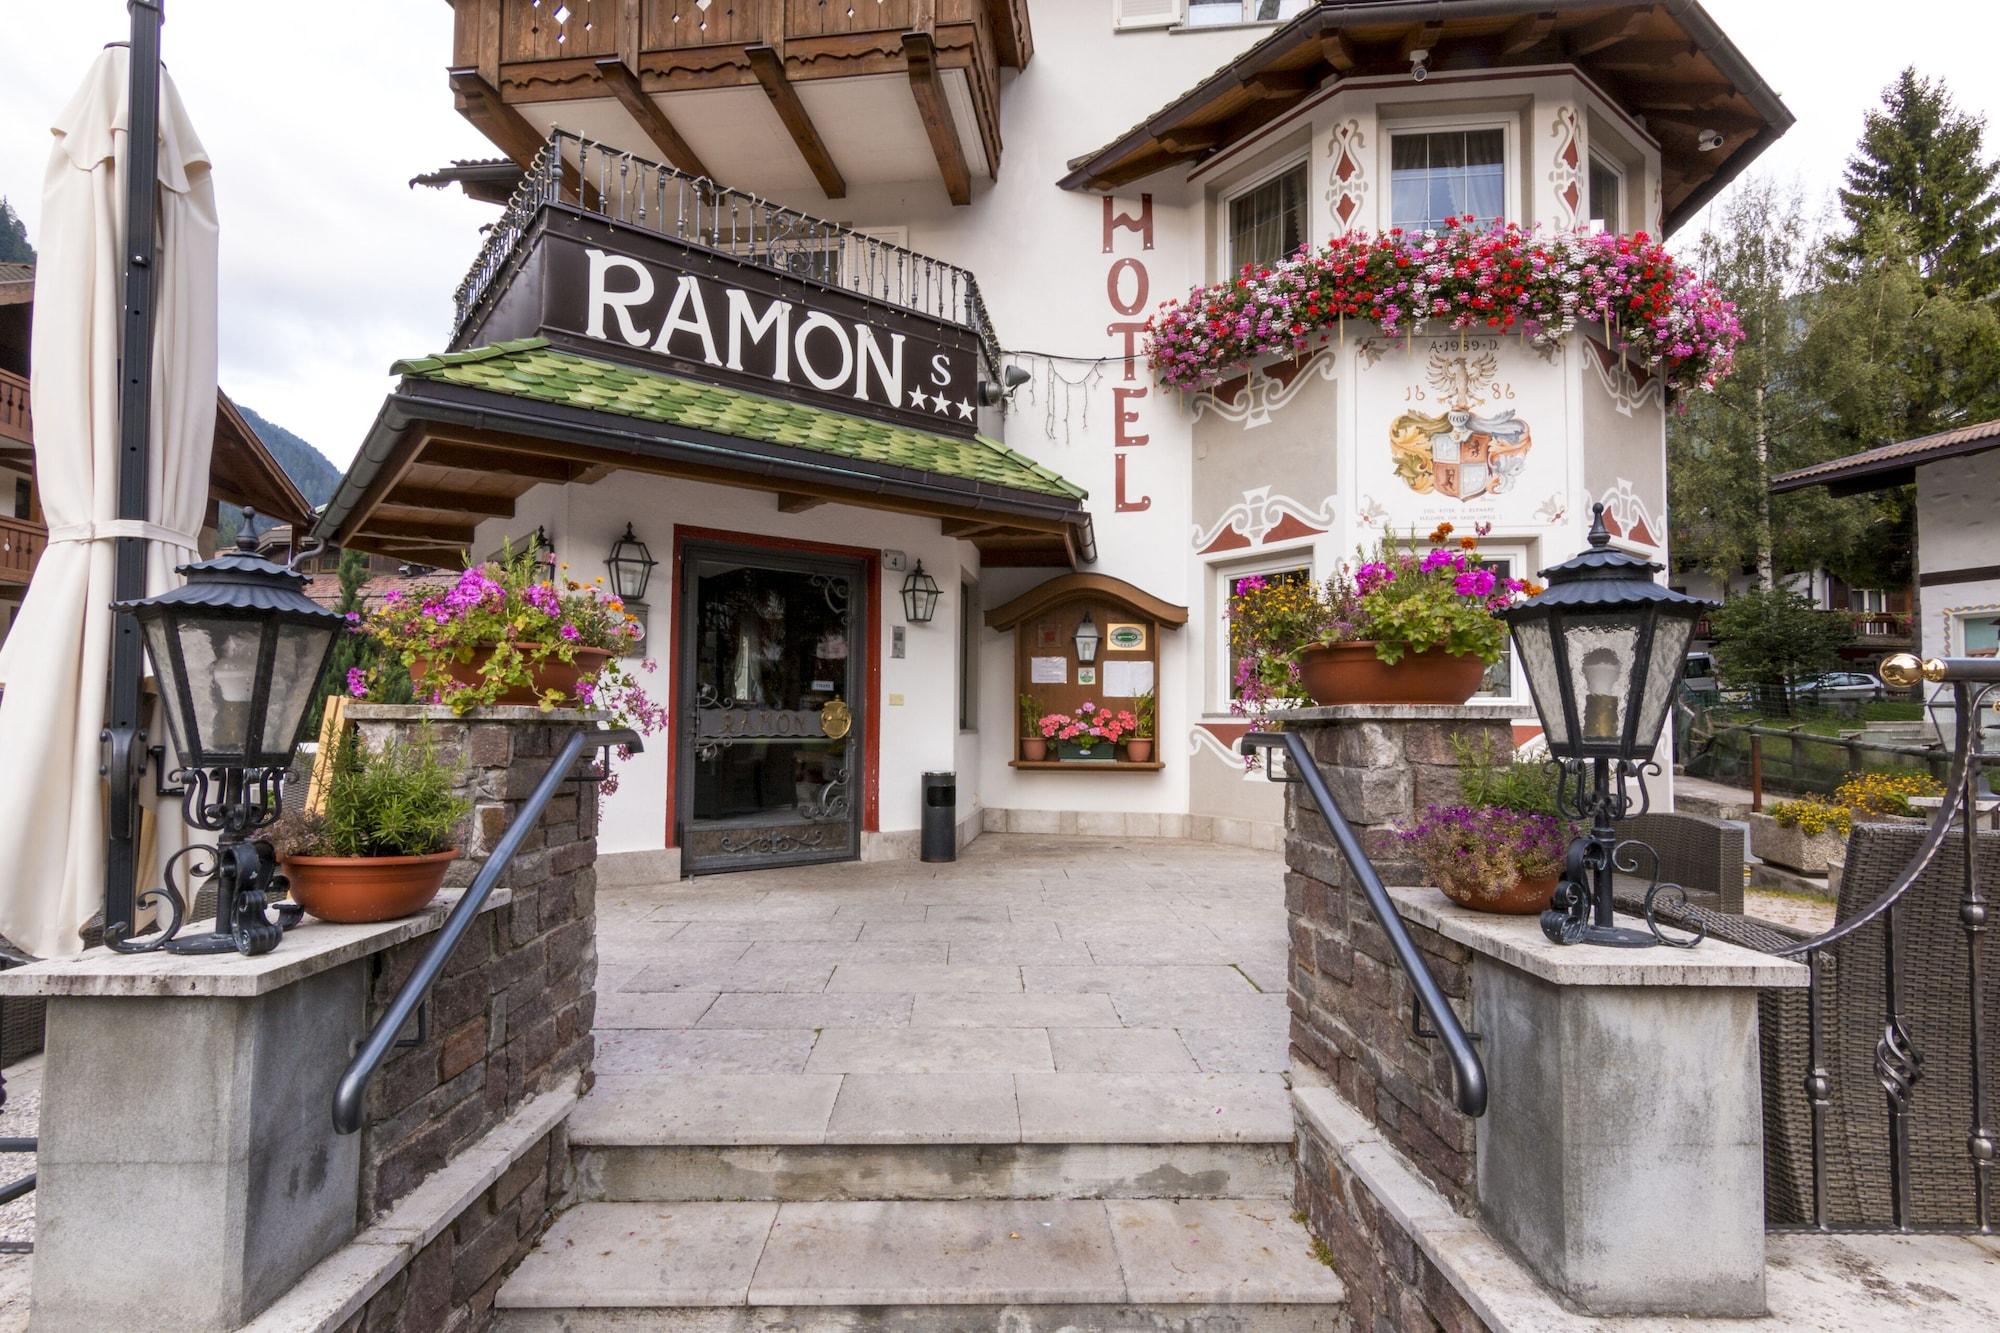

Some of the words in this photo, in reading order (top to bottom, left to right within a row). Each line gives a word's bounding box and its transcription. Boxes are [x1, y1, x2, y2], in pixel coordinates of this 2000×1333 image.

[584, 248, 906, 408] RAMON
[930, 353, 952, 386] S
[1102, 193, 1154, 513] HOTEL
